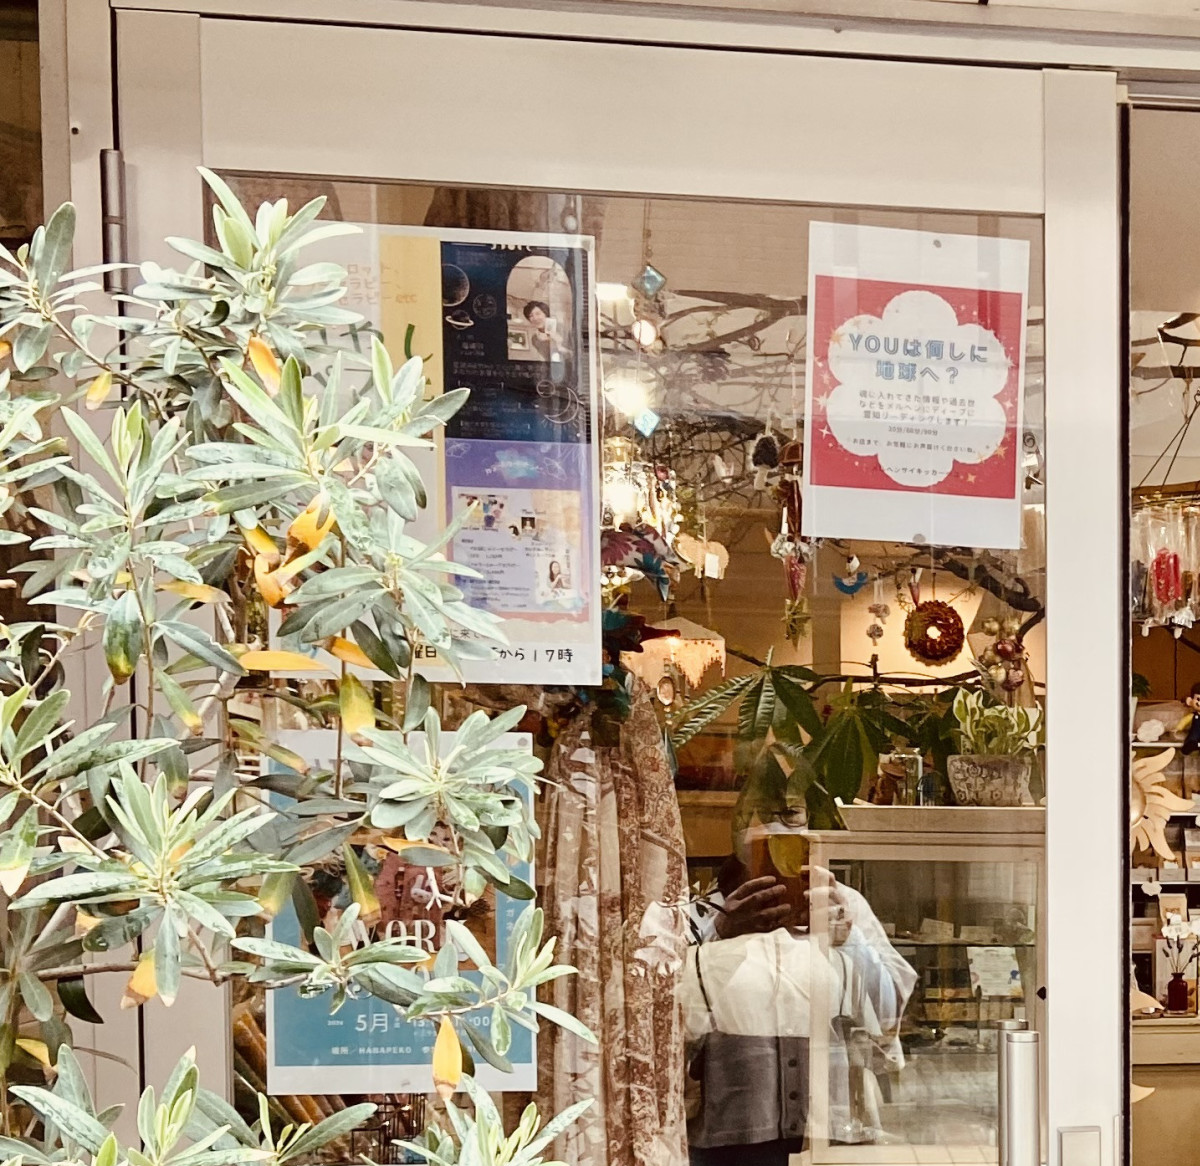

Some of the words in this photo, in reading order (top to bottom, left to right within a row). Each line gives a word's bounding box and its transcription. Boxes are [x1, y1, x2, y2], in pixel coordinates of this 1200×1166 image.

[848, 333, 989, 363] YOUは何しに
[354, 1012, 389, 1034] 5月
